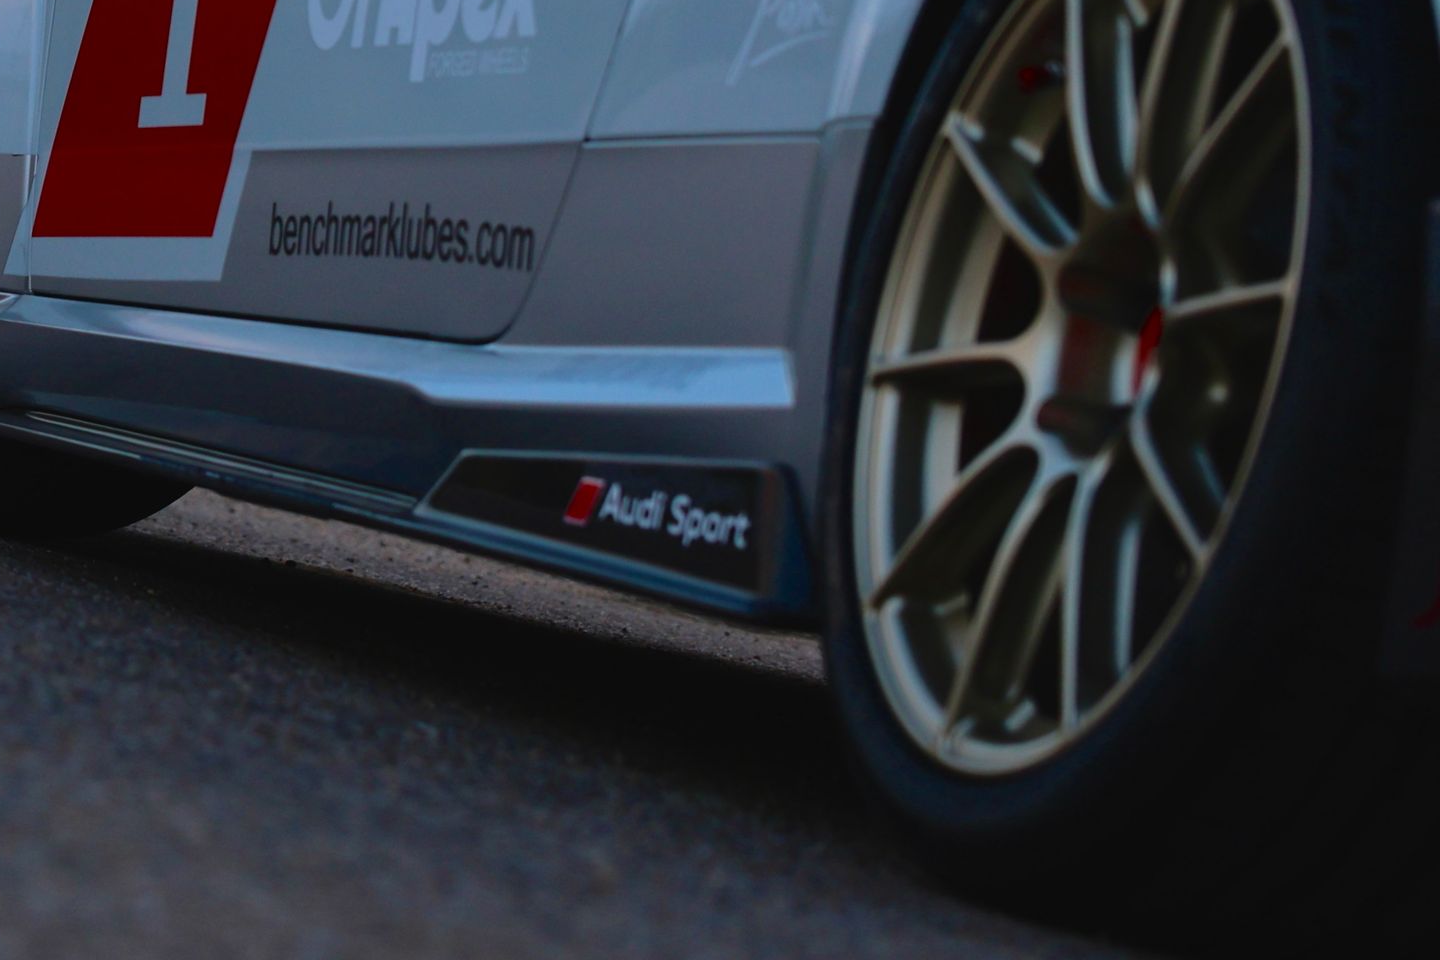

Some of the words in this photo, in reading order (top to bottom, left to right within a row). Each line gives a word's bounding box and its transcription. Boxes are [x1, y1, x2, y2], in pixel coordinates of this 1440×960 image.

[268, 199, 536, 273] benchmarklubes.com
[597, 481, 667, 531] Audi
[665, 492, 752, 550] Sport
